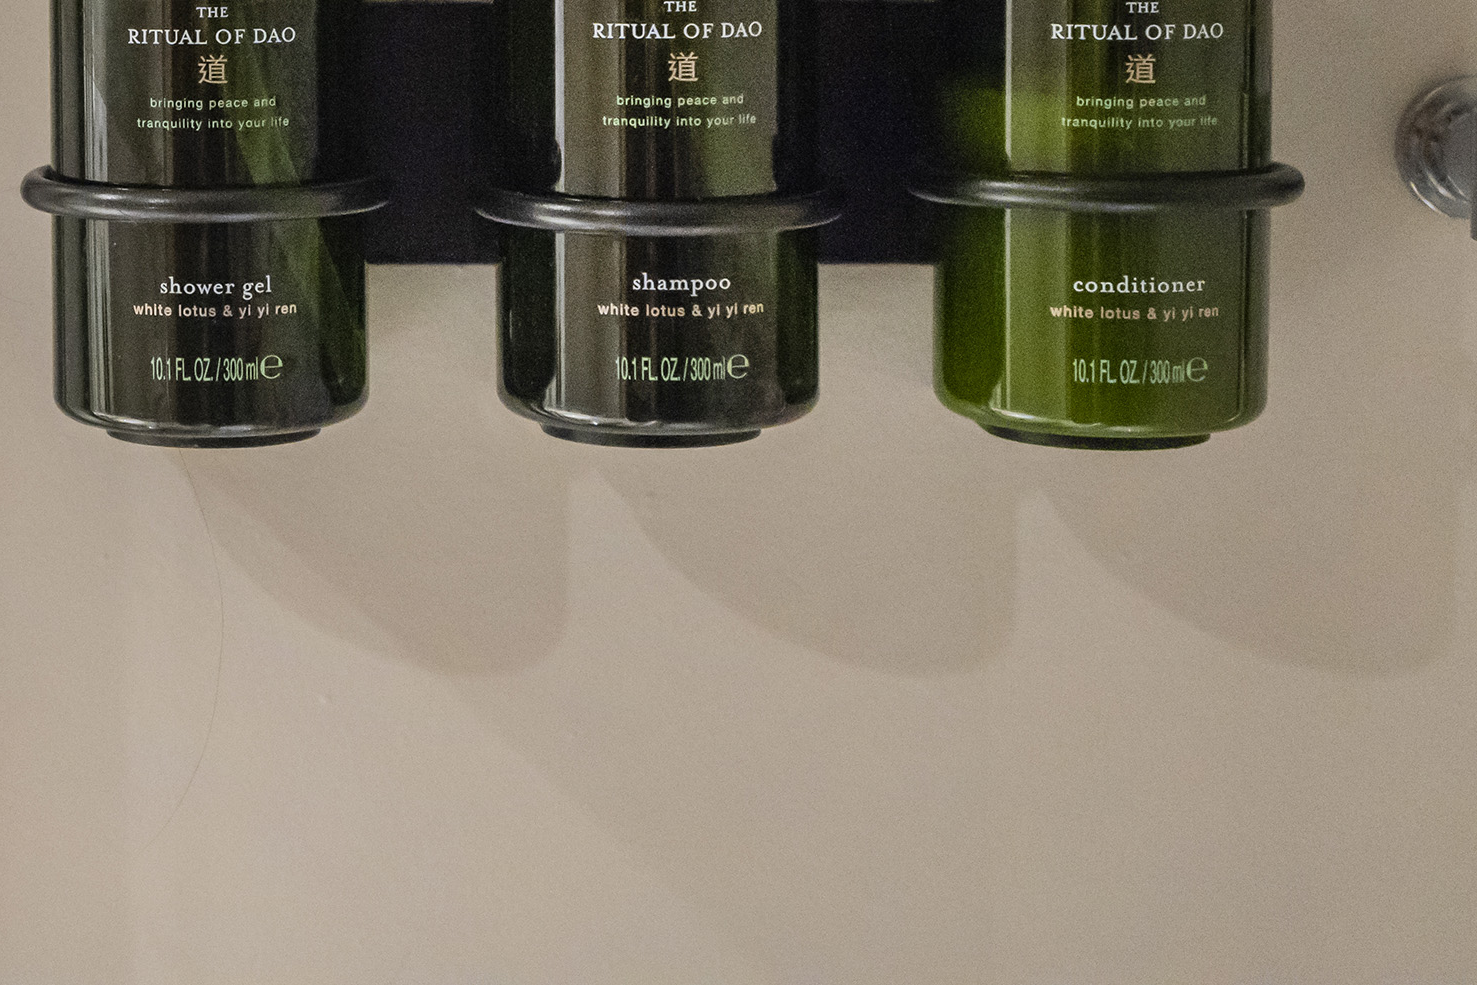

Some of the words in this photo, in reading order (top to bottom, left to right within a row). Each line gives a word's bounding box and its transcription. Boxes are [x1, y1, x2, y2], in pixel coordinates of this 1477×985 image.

[196, 7, 228, 18] THE
[664, 1, 697, 12] THE
[1126, 2, 1159, 13] THE
[128, 28, 207, 45] RITUAL
[215, 28, 245, 44] OF
[254, 26, 296, 44] DAO
[593, 23, 675, 39] RITUAL
[683, 23, 714, 39] OF
[721, 21, 762, 38] DAO
[1051, 24, 1137, 40] RITUAL
[1145, 24, 1176, 40] OF
[1183, 23, 1224, 39] DAO
[198, 54, 228, 85] 道
[668, 52, 699, 82] 道
[1125, 54, 1156, 84] 道
[150, 97, 203, 110] bringing
[209, 98, 248, 110] peace
[254, 96, 276, 107] and
[616, 95, 672, 108] bringing
[678, 96, 717, 107] peace
[722, 94, 744, 105] and
[1076, 96, 1134, 109] bringing
[1139, 97, 1179, 108] peace
[1184, 95, 1206, 106] and
[137, 117, 202, 131] tranquility
[208, 118, 233, 129] into
[238, 119, 266, 130] your
[271, 116, 289, 127] life
[603, 115, 670, 128] tranquility
[676, 115, 701, 126] into
[706, 116, 734, 127] your
[739, 114, 756, 124] life
[1062, 116, 1133, 130] tranquility
[1138, 116, 1163, 127] into
[1168, 118, 1196, 129] your
[1201, 115, 1217, 126] life
[160, 276, 234, 294] shower
[242, 275, 271, 300] gel
[633, 272, 731, 296] shampoo
[1073, 275, 1205, 293] conditioner
[133, 304, 172, 317] white
[179, 304, 216, 317] lotus
[223, 305, 232, 317] &
[239, 304, 251, 319] yi
[257, 304, 269, 318] yi
[275, 304, 297, 314] ren
[598, 304, 639, 316] white
[646, 304, 685, 317] lotus
[692, 305, 702, 317] &
[707, 304, 720, 319] yi
[726, 303, 738, 318] yi
[743, 303, 764, 314] ren
[1050, 305, 1093, 319] white
[1101, 307, 1140, 319] lotus
[1147, 307, 1157, 319] &
[1163, 307, 1176, 322] yi
[1182, 307, 1194, 321] yi
[1198, 306, 1219, 317] ren
[151, 357, 171, 380] 10.1
[176, 358, 191, 381] FL.
[194, 358, 213, 381] OZ.
[223, 358, 243, 382] 300
[616, 357, 637, 380] 10.1
[642, 357, 658, 381] FL.
[661, 357, 680, 381] OZ.
[690, 358, 711, 381] 300
[1073, 359, 1095, 382] 10.1
[1100, 360, 1116, 383] FL.
[1120, 360, 1139, 384] OZ.
[1150, 361, 1170, 383] 300
